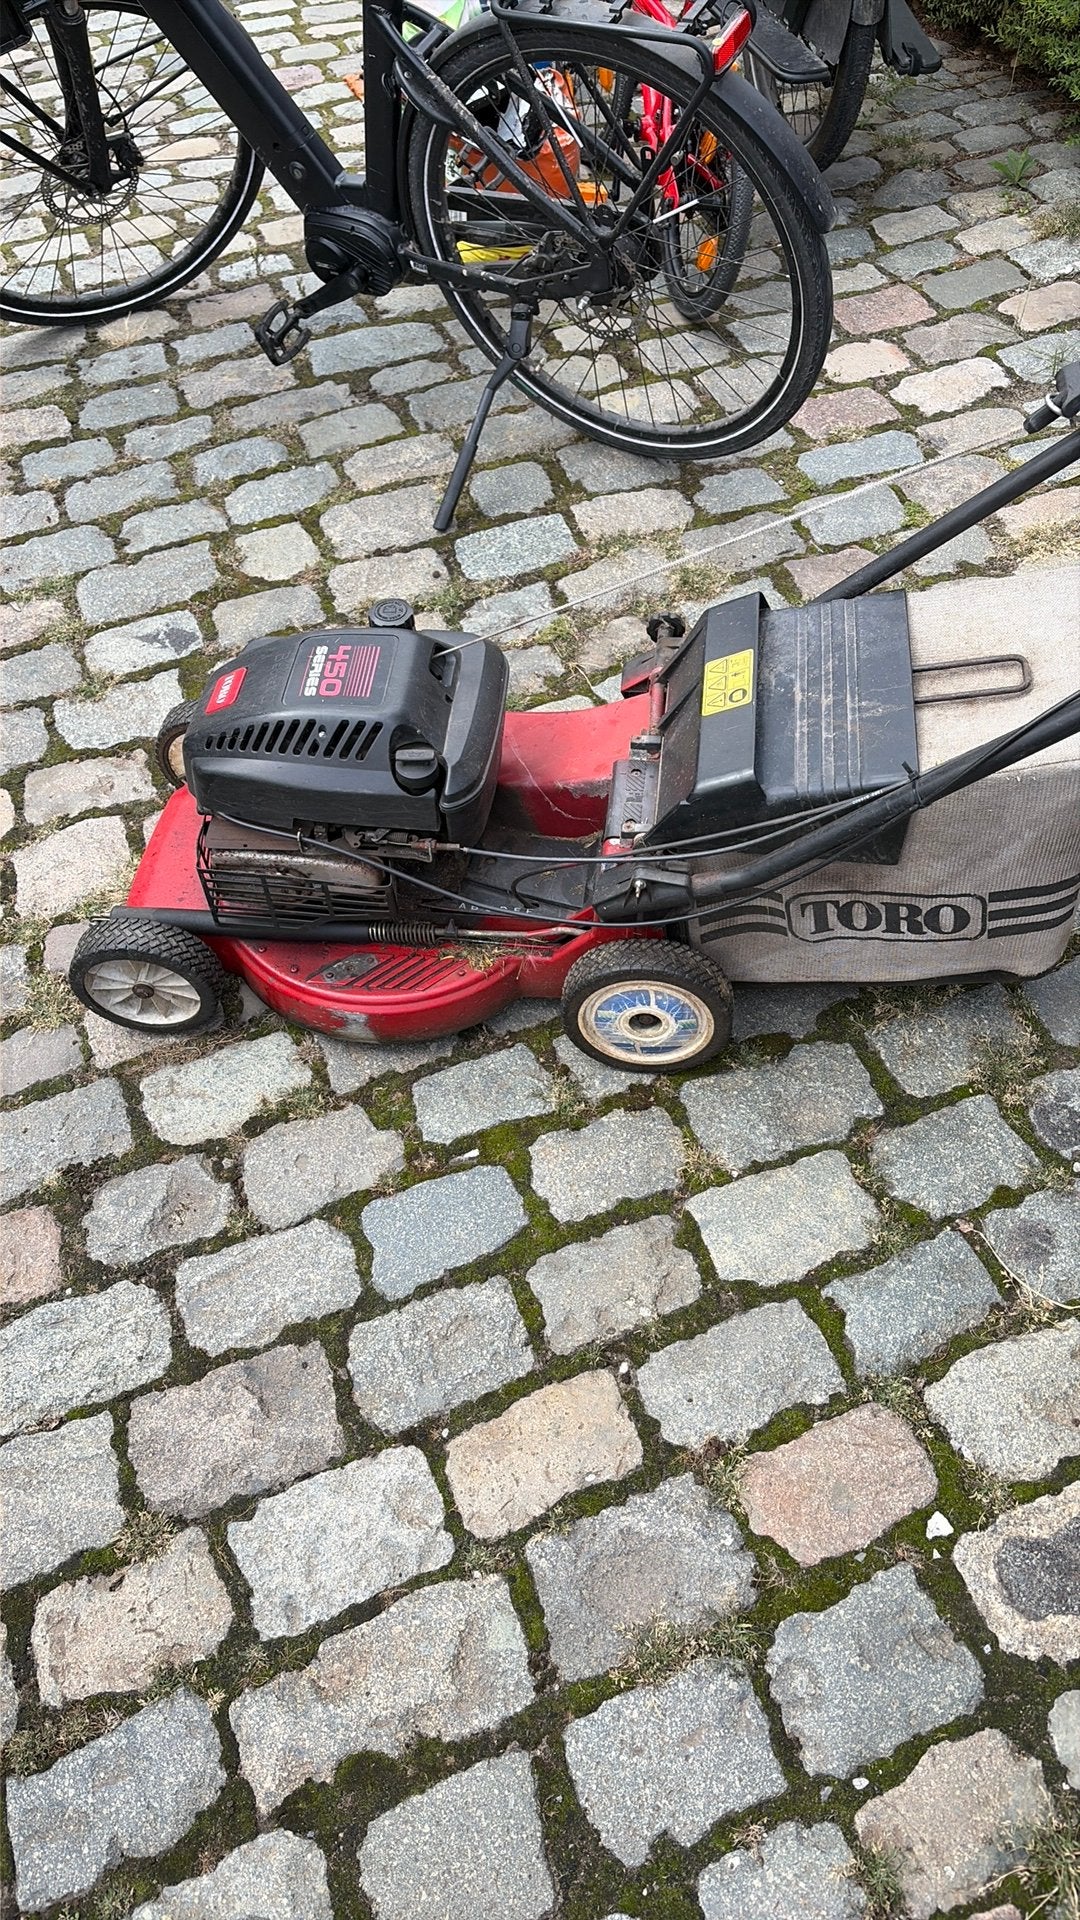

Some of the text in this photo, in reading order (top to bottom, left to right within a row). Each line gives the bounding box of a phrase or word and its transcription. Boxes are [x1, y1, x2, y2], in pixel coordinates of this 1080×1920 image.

[304, 645, 329, 697] SERIES
[319, 645, 352, 696] 450
[800, 900, 971, 935] TORO
